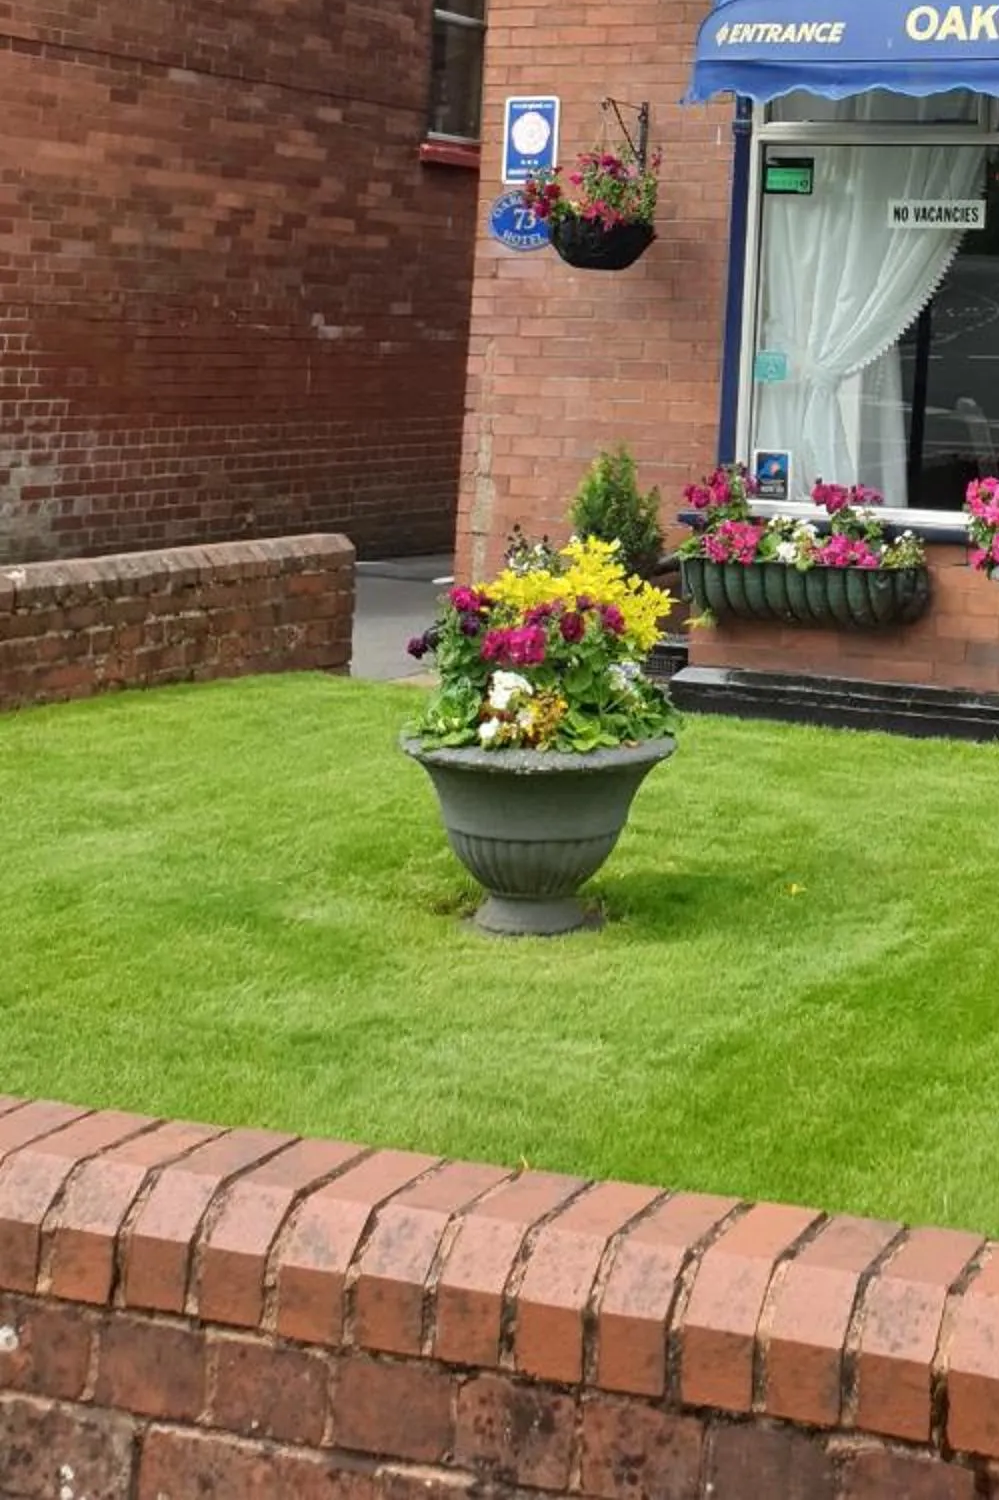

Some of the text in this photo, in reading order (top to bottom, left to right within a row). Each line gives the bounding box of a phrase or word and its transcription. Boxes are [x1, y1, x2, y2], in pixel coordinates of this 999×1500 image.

[727, 21, 844, 44] ENTRANCE
[513, 208, 537, 230] 73
[893, 206, 979, 223] NO VACANCIES
